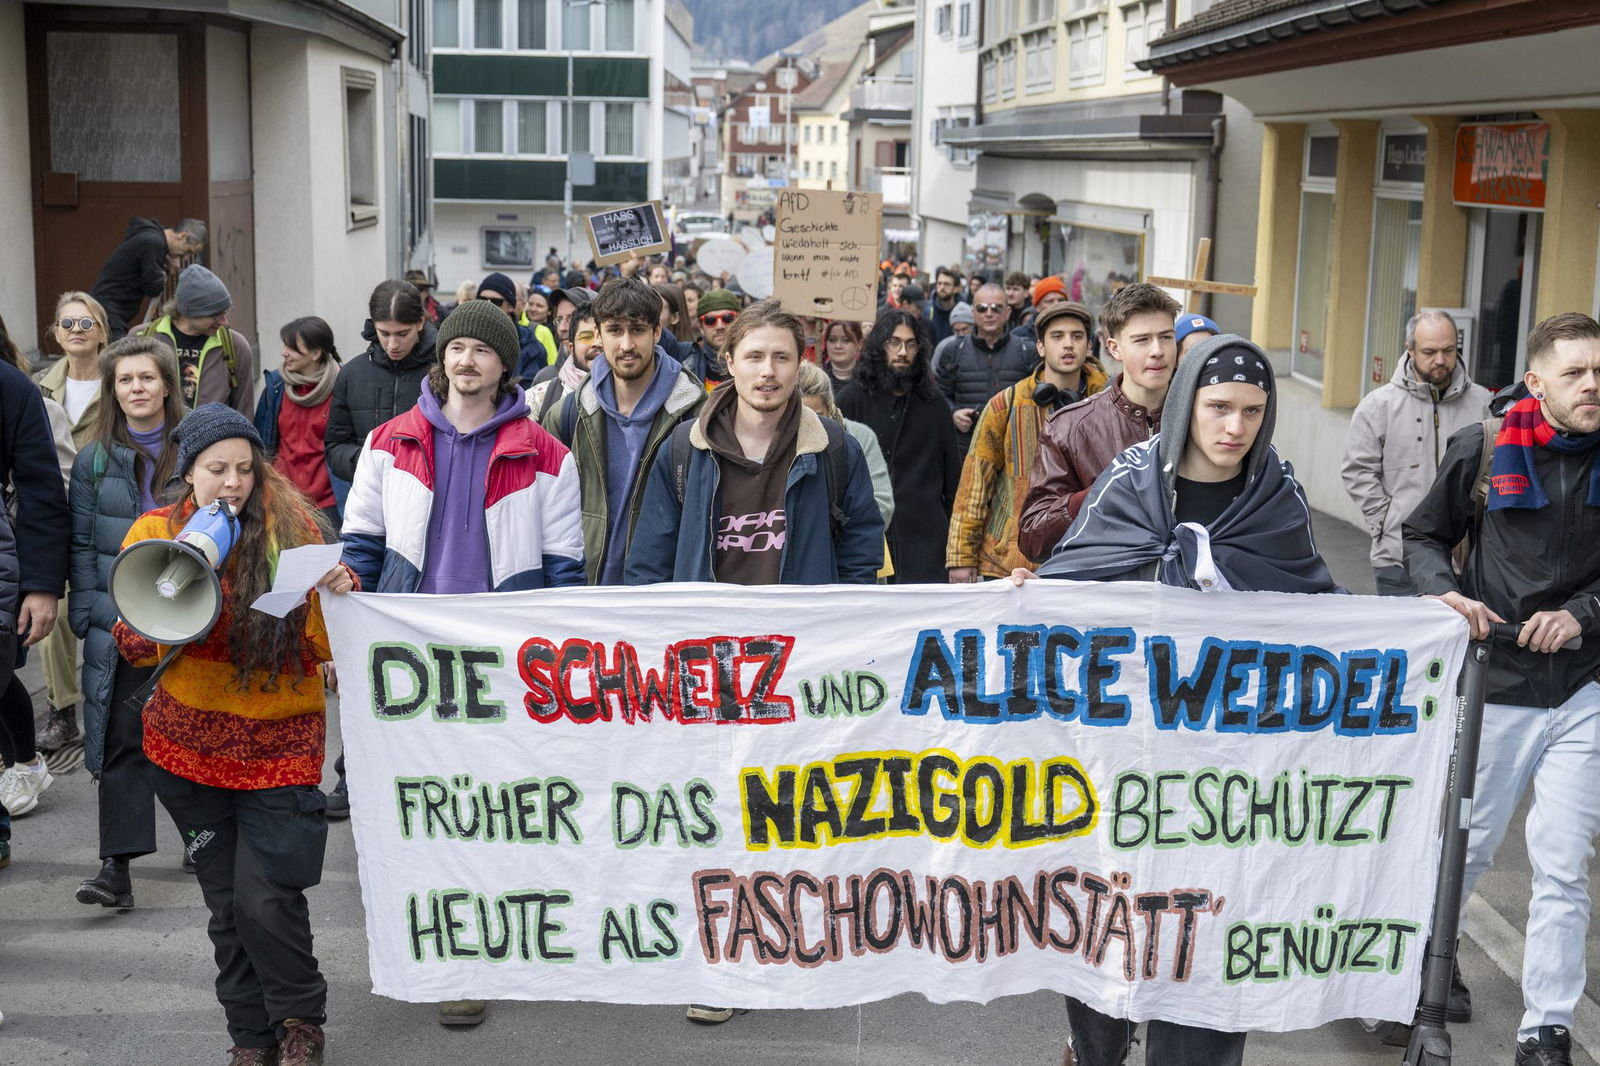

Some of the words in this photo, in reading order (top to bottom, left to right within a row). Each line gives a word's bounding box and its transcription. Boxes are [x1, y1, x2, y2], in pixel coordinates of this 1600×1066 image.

[604, 210, 635, 224] HASS
[780, 191, 810, 213] AfD
[608, 235, 655, 251] HÄSSLICH
[369, 641, 506, 723] DIE
[517, 636, 795, 725] SCHWEIZ
[799, 670, 889, 719] UND
[900, 624, 1136, 727] ALICE
[1143, 636, 1443, 737] WEIDEL:
[395, 773, 584, 845] FRÜHER
[611, 778, 722, 849] DAS
[739, 748, 1101, 851] NAZIGOLD
[1110, 766, 1414, 849] BESCHÜTZT
[406, 889, 578, 964] HEUTE
[601, 898, 683, 963] ALS
[1223, 903, 1421, 985] BENÜTZT
